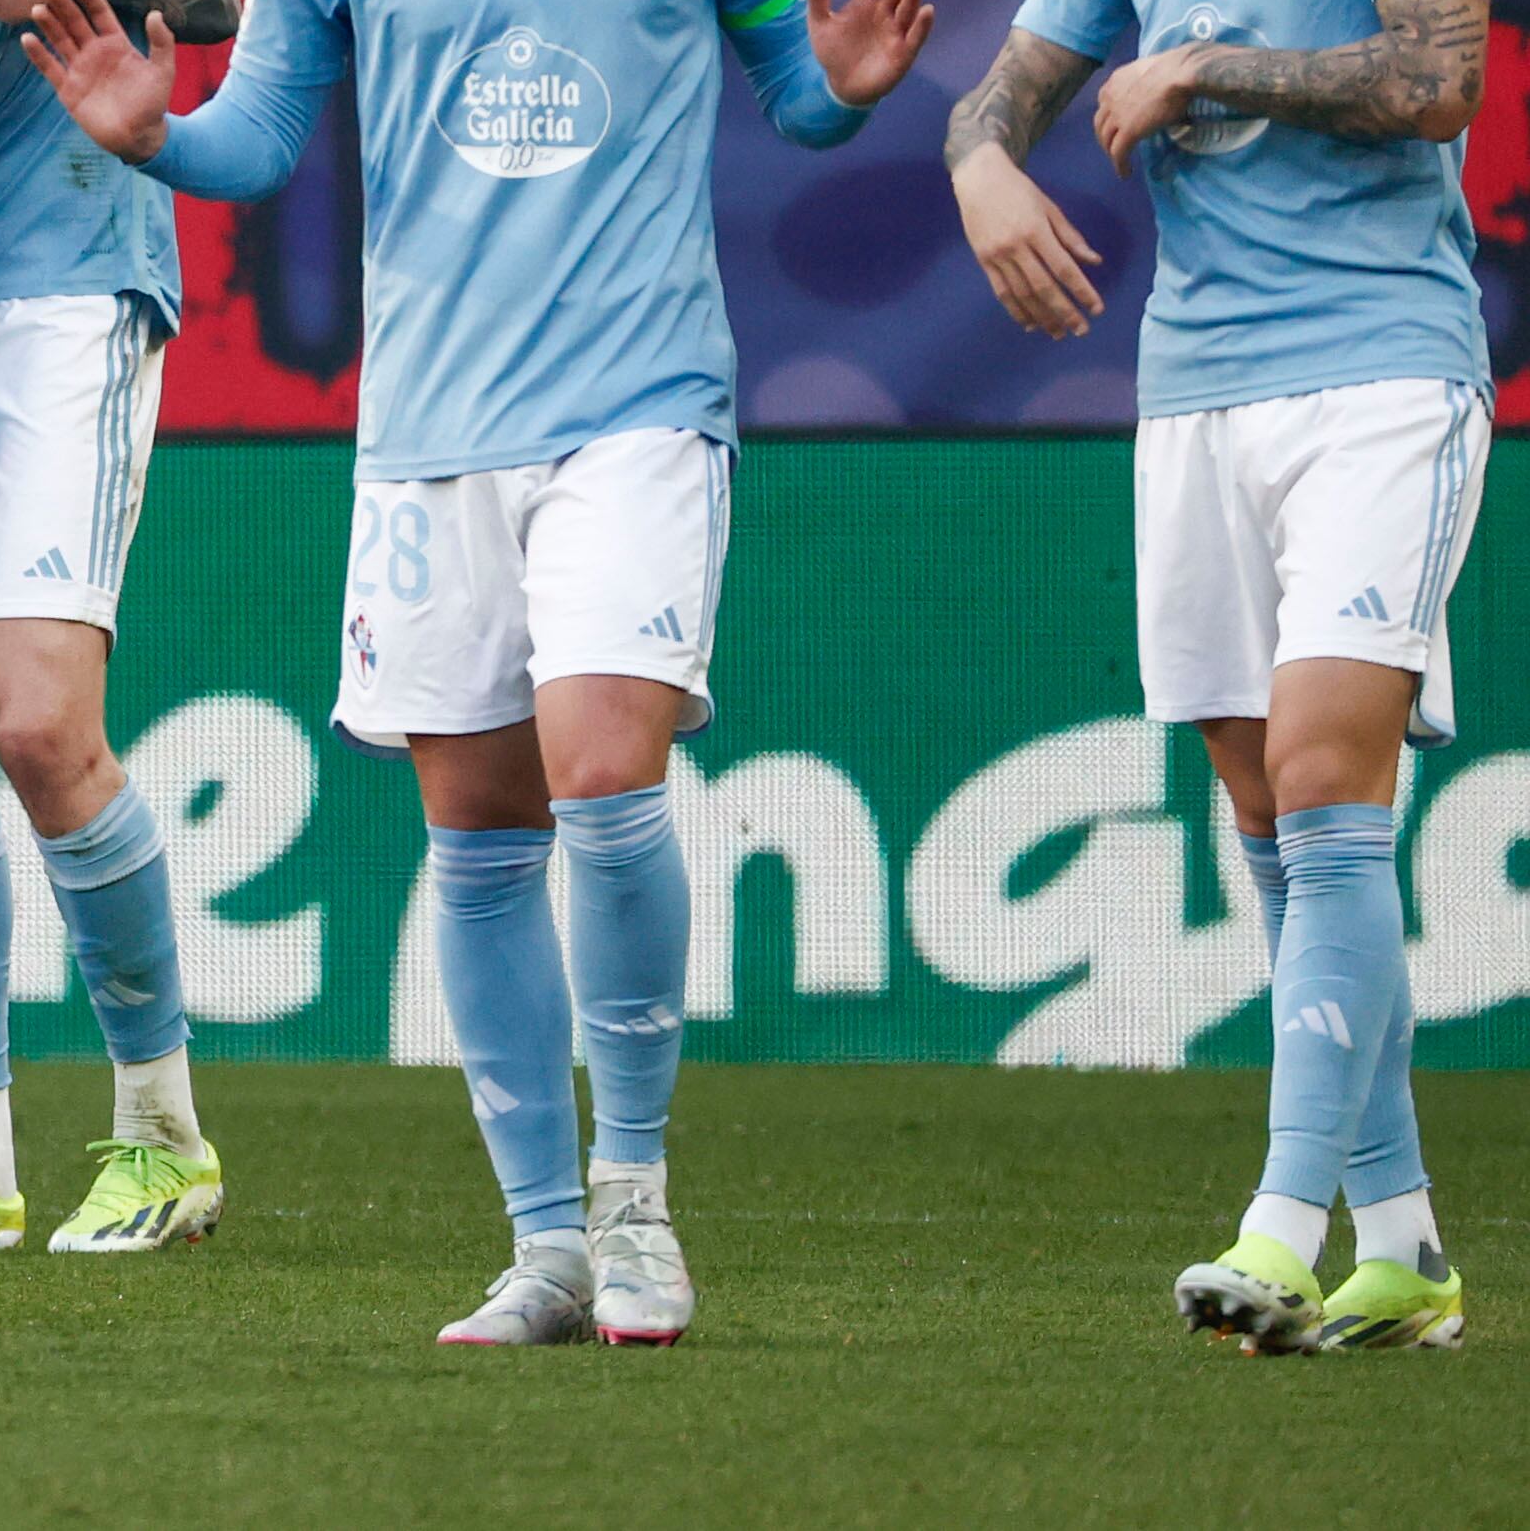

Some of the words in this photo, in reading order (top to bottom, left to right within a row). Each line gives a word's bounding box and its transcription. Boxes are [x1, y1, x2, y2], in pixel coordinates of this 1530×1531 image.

[463, 72, 581, 107] Estrella
[467, 106, 575, 142] Galicia
[353, 495, 430, 602] 28
